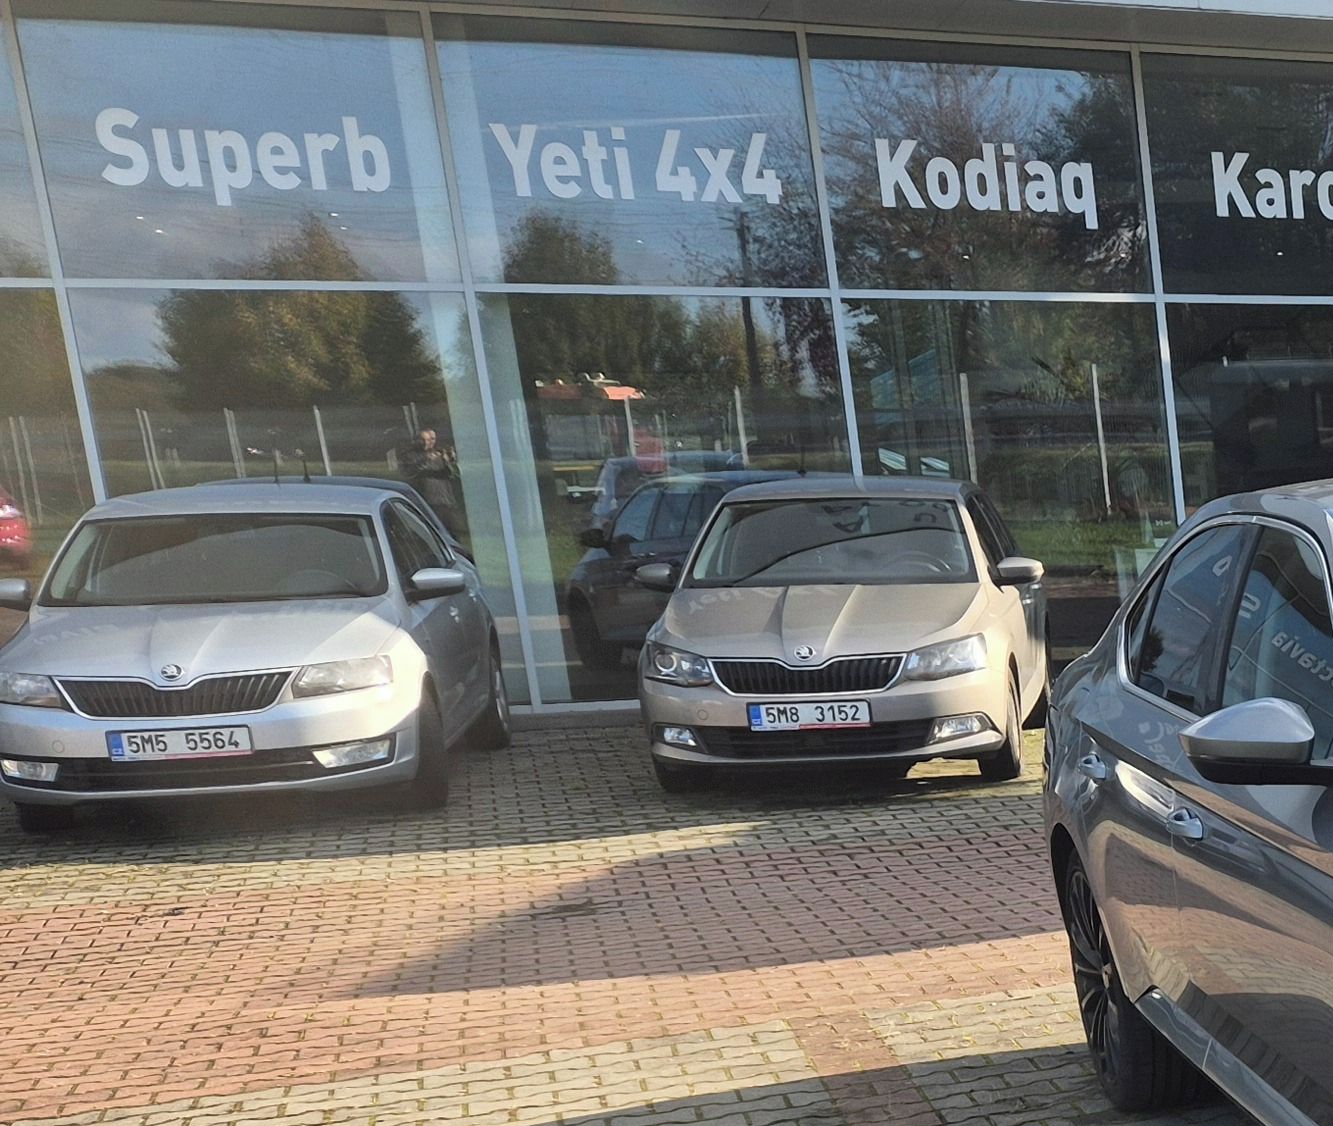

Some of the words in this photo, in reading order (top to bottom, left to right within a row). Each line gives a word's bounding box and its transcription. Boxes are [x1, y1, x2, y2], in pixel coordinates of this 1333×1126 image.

[95, 107, 391, 206] Superb
[489, 123, 635, 200] Yeti
[655, 129, 783, 204] 4x4
[875, 138, 1098, 230] Kodiaq
[127, 734, 168, 754] 5M5
[185, 731, 240, 751] 5564
[765, 706, 800, 723] 5M8
[814, 704, 861, 722] 3152
